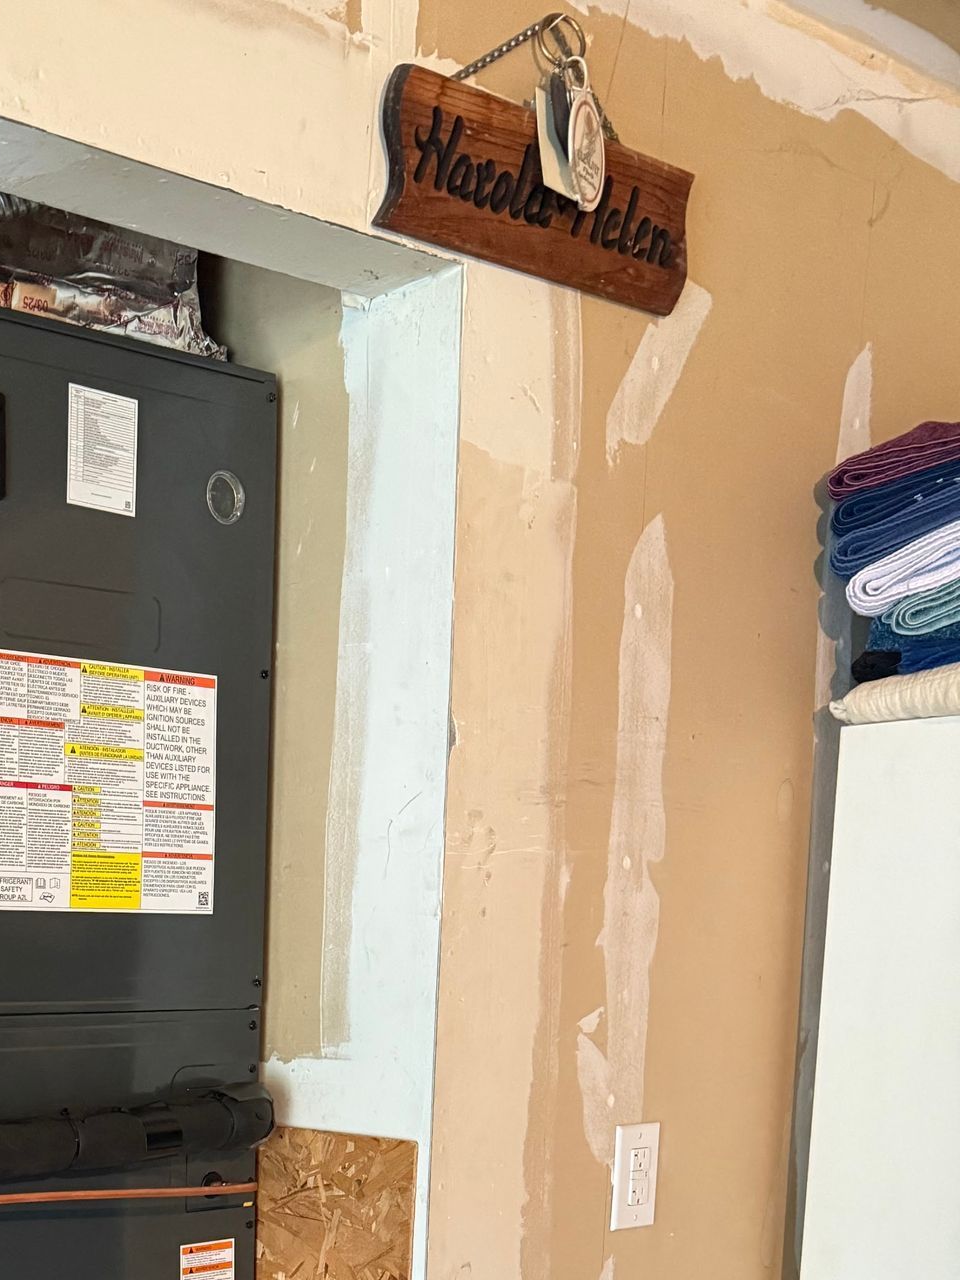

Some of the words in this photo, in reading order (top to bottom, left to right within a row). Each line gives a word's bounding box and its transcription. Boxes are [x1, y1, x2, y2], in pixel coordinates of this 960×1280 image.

[23, 296, 48, 312] 03/25
[166, 676, 195, 685] WARNING
[147, 684, 161, 693] RISK
[163, 686, 171, 694] OF
[173, 687, 186, 695] FIRE
[146, 694, 178, 704] AUXILIARY
[180, 698, 206, 707] DEVICES
[146, 704, 168, 713] WHICH
[147, 714, 174, 723] IGNITION
[176, 716, 205, 726] SOURCES
[146, 723, 166, 732] SHALL
[168, 725, 180, 733] NOT
[147, 733, 180, 743] INSTALLED
[186, 746, 207, 754] OTHER
[146, 752, 163, 761] THAN
[165, 754, 196, 762] AUXILIARY
[146, 762, 173, 771] DEVICES
[175, 764, 196, 773] LISTED
[197, 766, 210, 774] FOR
[146, 781, 174, 790] SPECIFIC
[0, 885, 22, 893] SAFETY
